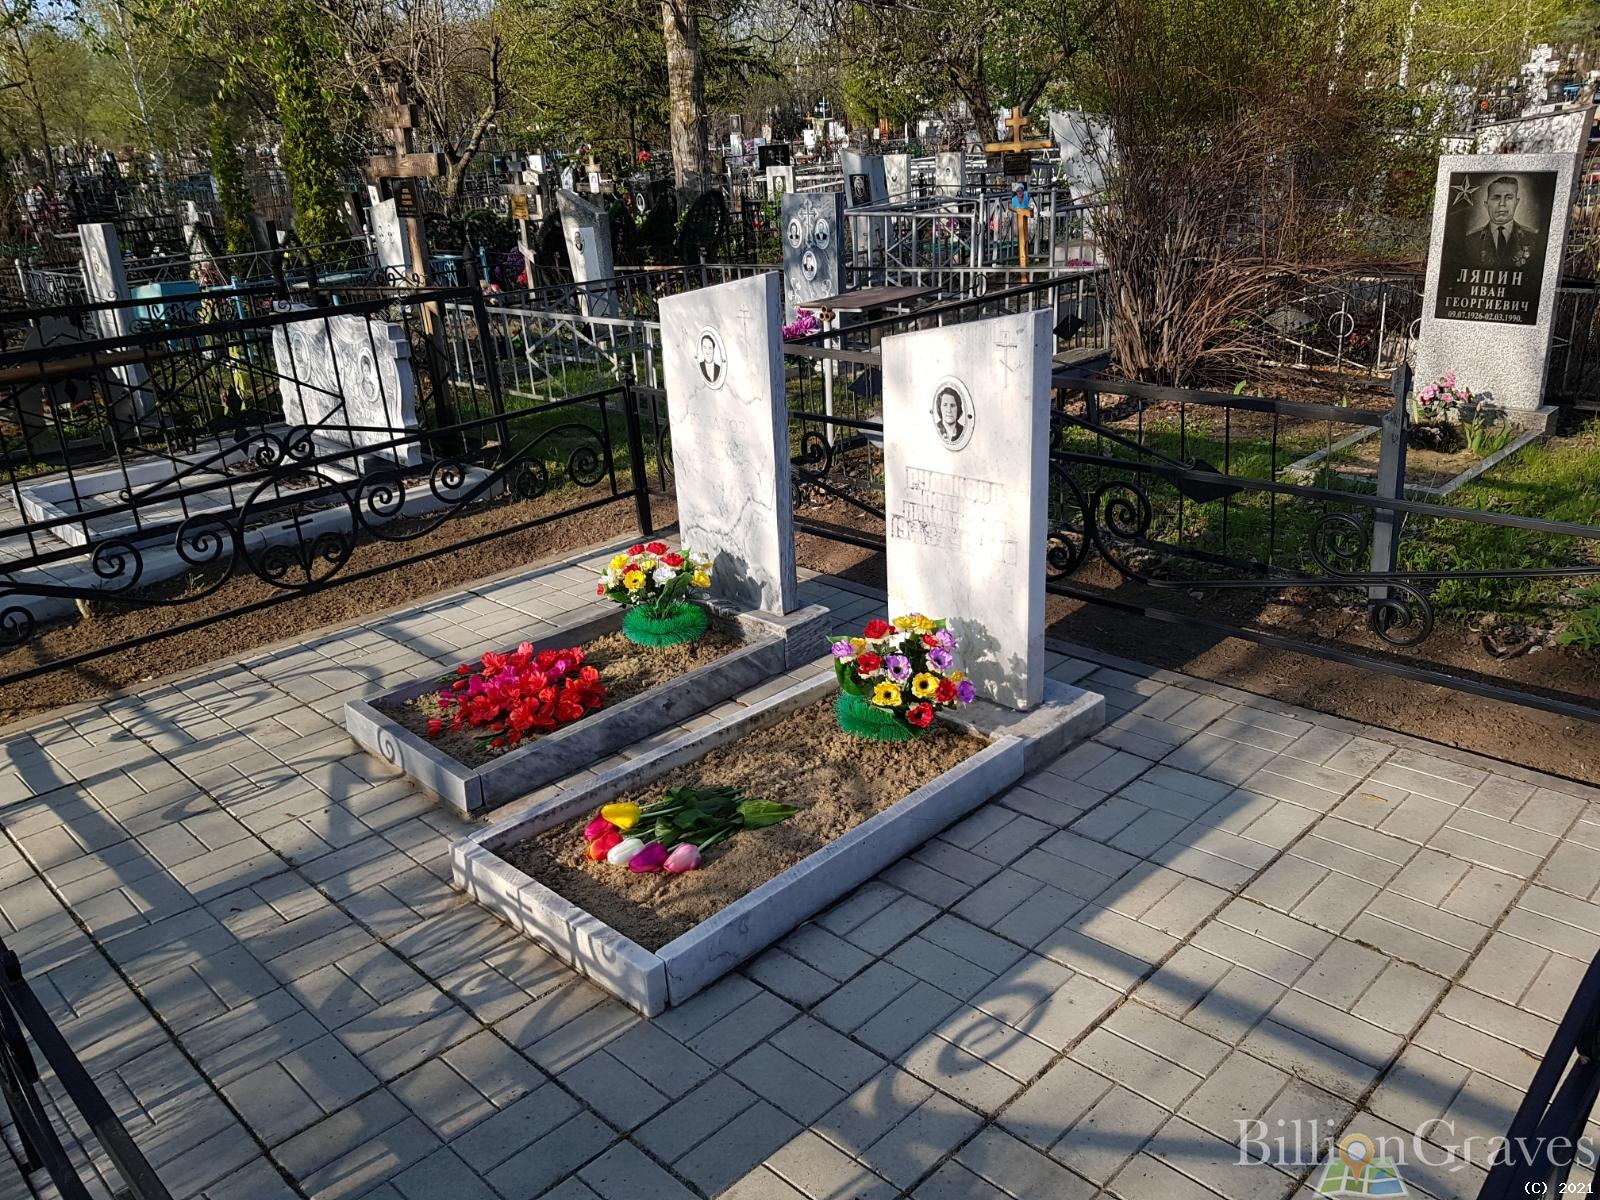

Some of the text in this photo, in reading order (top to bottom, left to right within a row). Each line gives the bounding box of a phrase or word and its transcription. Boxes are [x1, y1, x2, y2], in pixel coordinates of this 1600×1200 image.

[1456, 268, 1523, 285] ЛЯПИН
[1470, 285, 1506, 297] ИВАН
[1444, 296, 1529, 311] ГЕОРГИЕВИЧ
